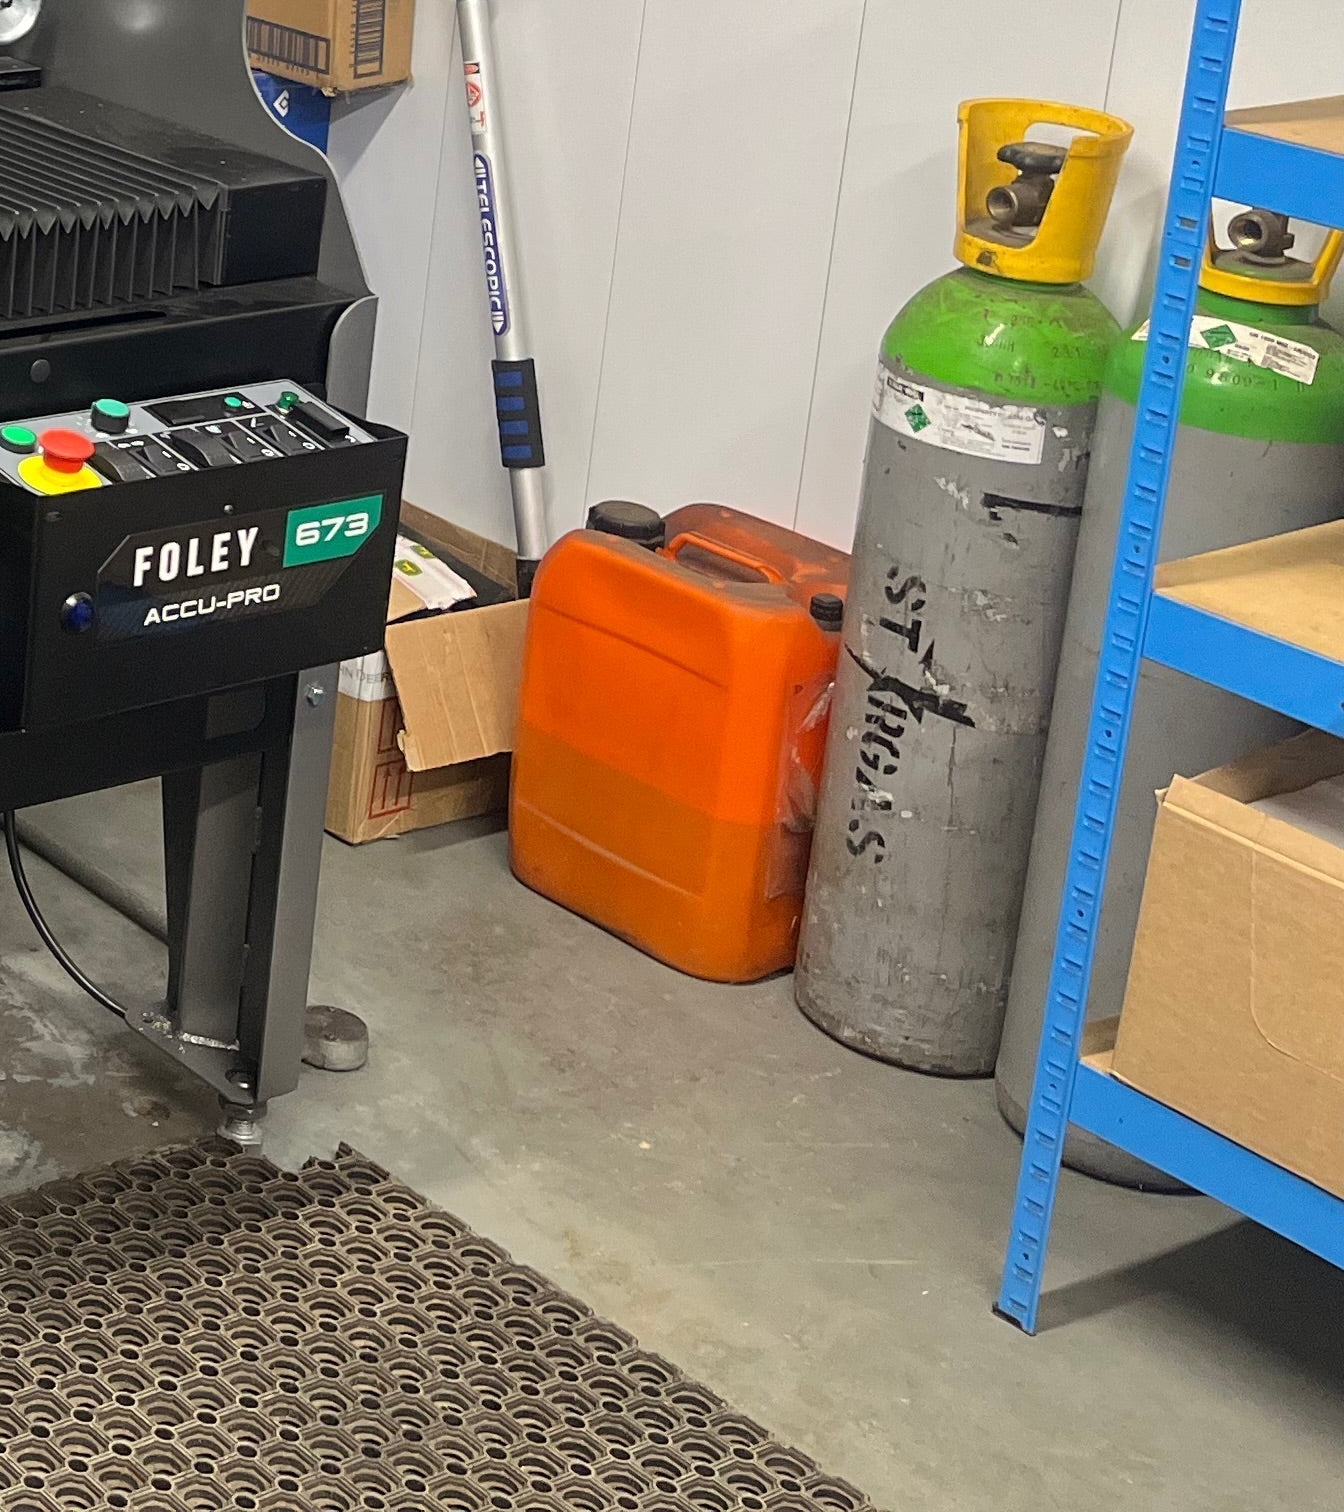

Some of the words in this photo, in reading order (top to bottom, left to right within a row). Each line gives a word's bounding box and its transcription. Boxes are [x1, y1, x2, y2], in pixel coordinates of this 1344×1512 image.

[294, 512, 370, 548] 673
[132, 526, 260, 588] FOLEY
[142, 582, 281, 627] ACCU-PRO
[355, 669, 392, 685] DEER
